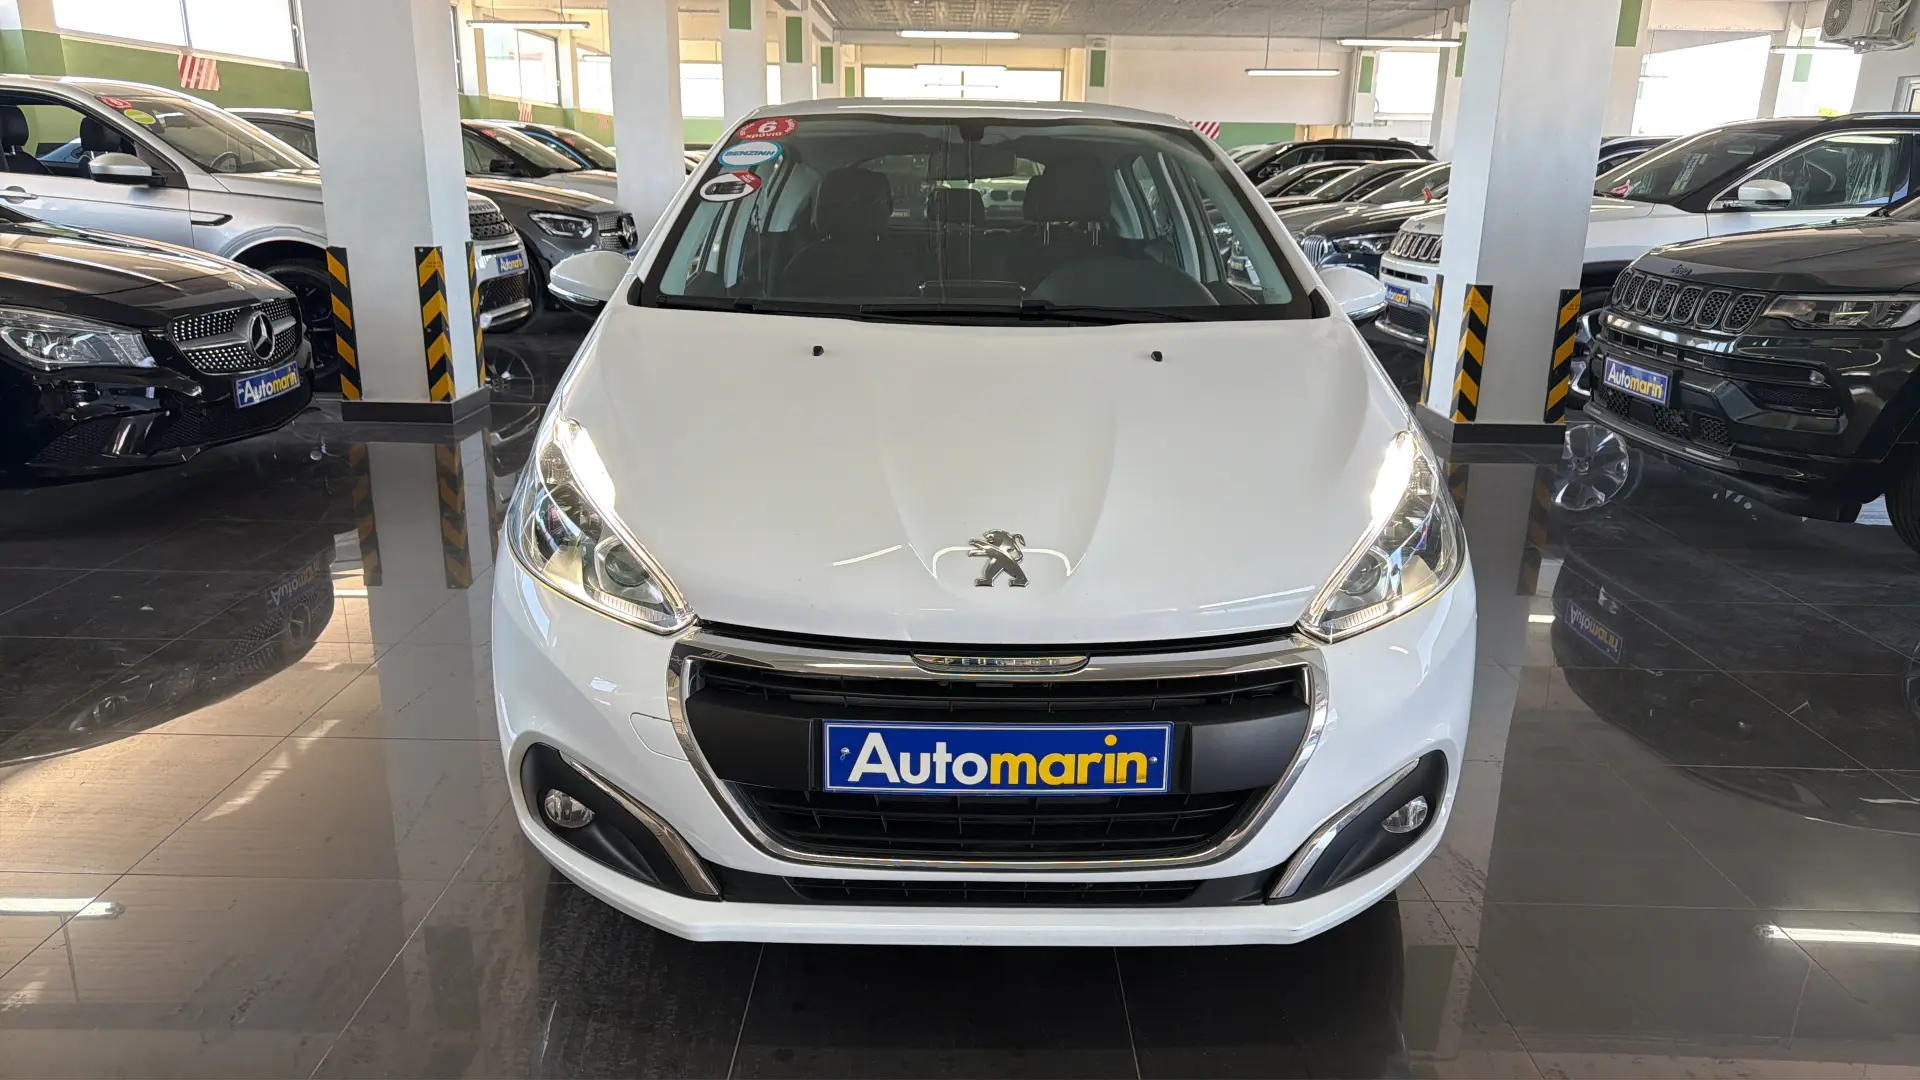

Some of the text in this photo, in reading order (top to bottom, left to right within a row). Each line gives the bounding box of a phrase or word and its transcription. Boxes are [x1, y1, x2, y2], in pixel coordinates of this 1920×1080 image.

[757, 120, 778, 133] 6
[244, 366, 298, 404] Automarin
[1607, 362, 1664, 399] Automarin
[944, 656, 1061, 666] PEUGEOT
[847, 732, 1149, 785] Automarin
